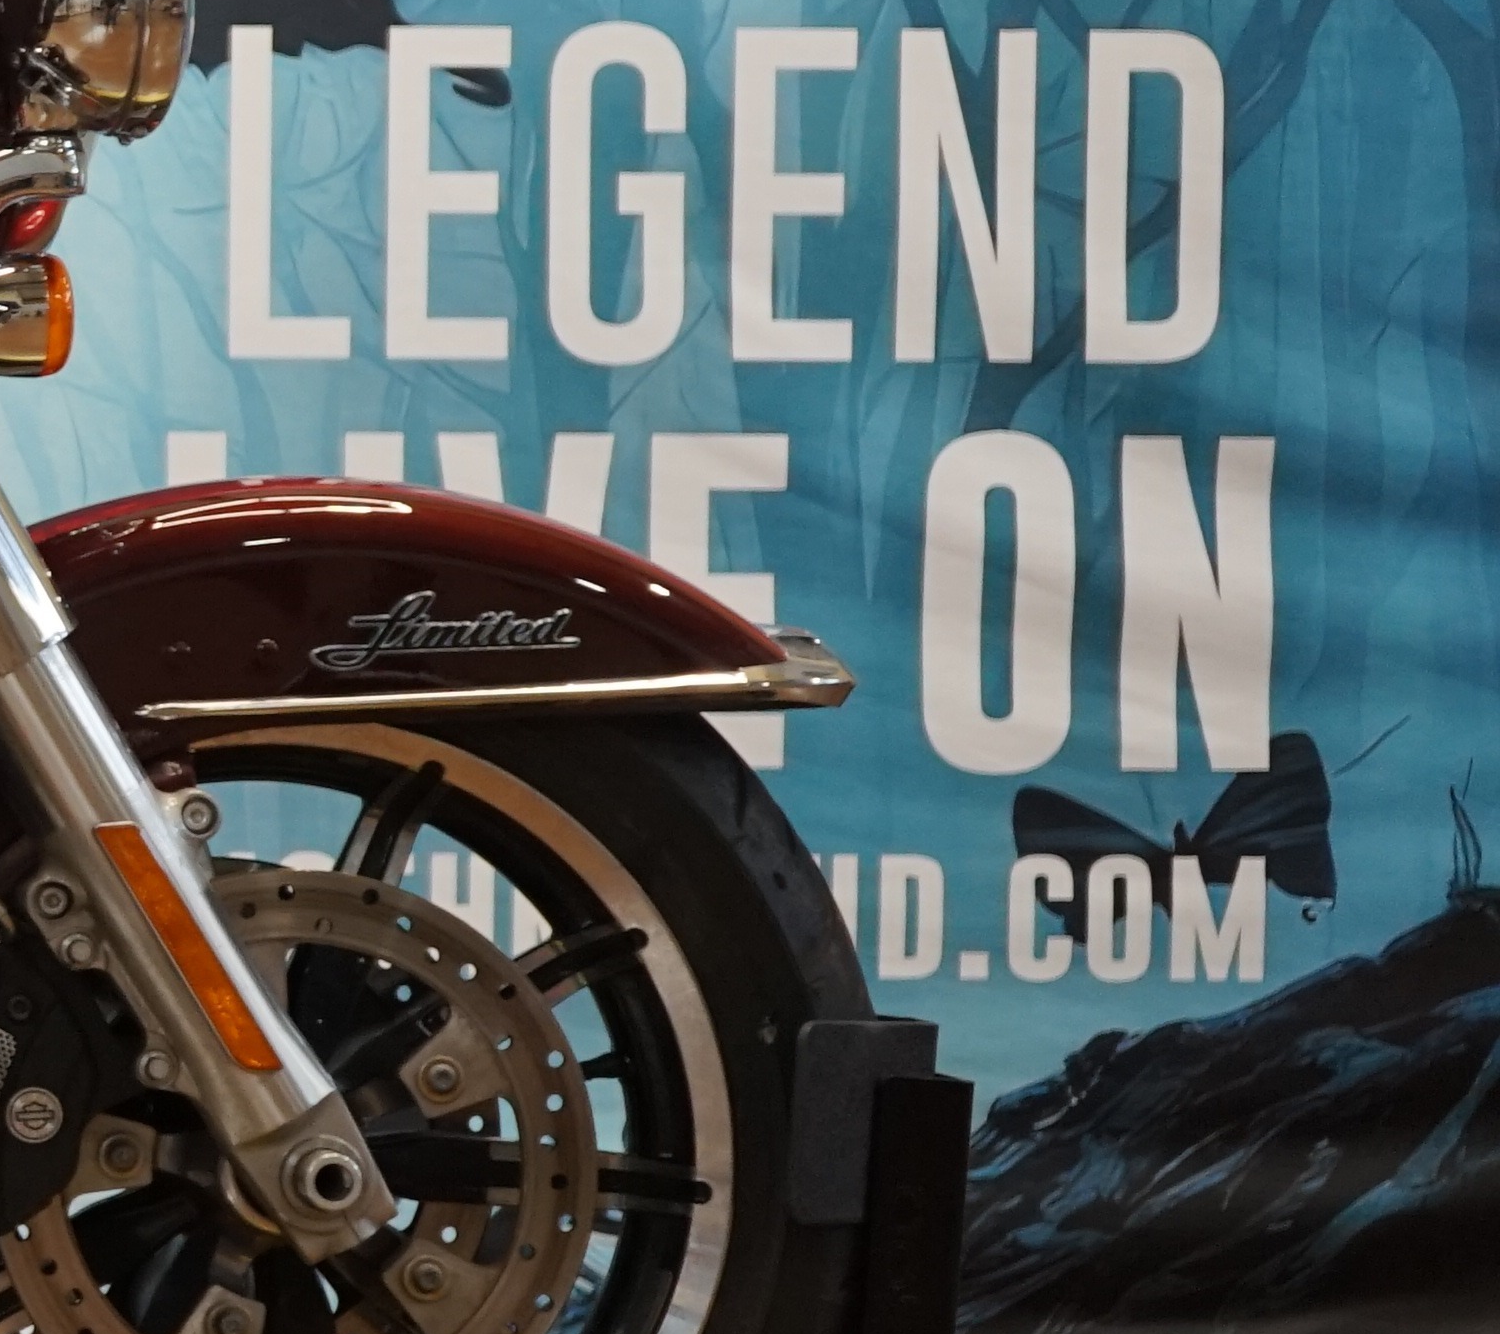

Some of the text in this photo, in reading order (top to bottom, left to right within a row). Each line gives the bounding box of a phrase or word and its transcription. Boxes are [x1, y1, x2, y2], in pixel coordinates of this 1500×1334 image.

[225, 20, 1226, 367] LEGEND
[310, 590, 582, 671] Limited
[920, 428, 1276, 776] ON
